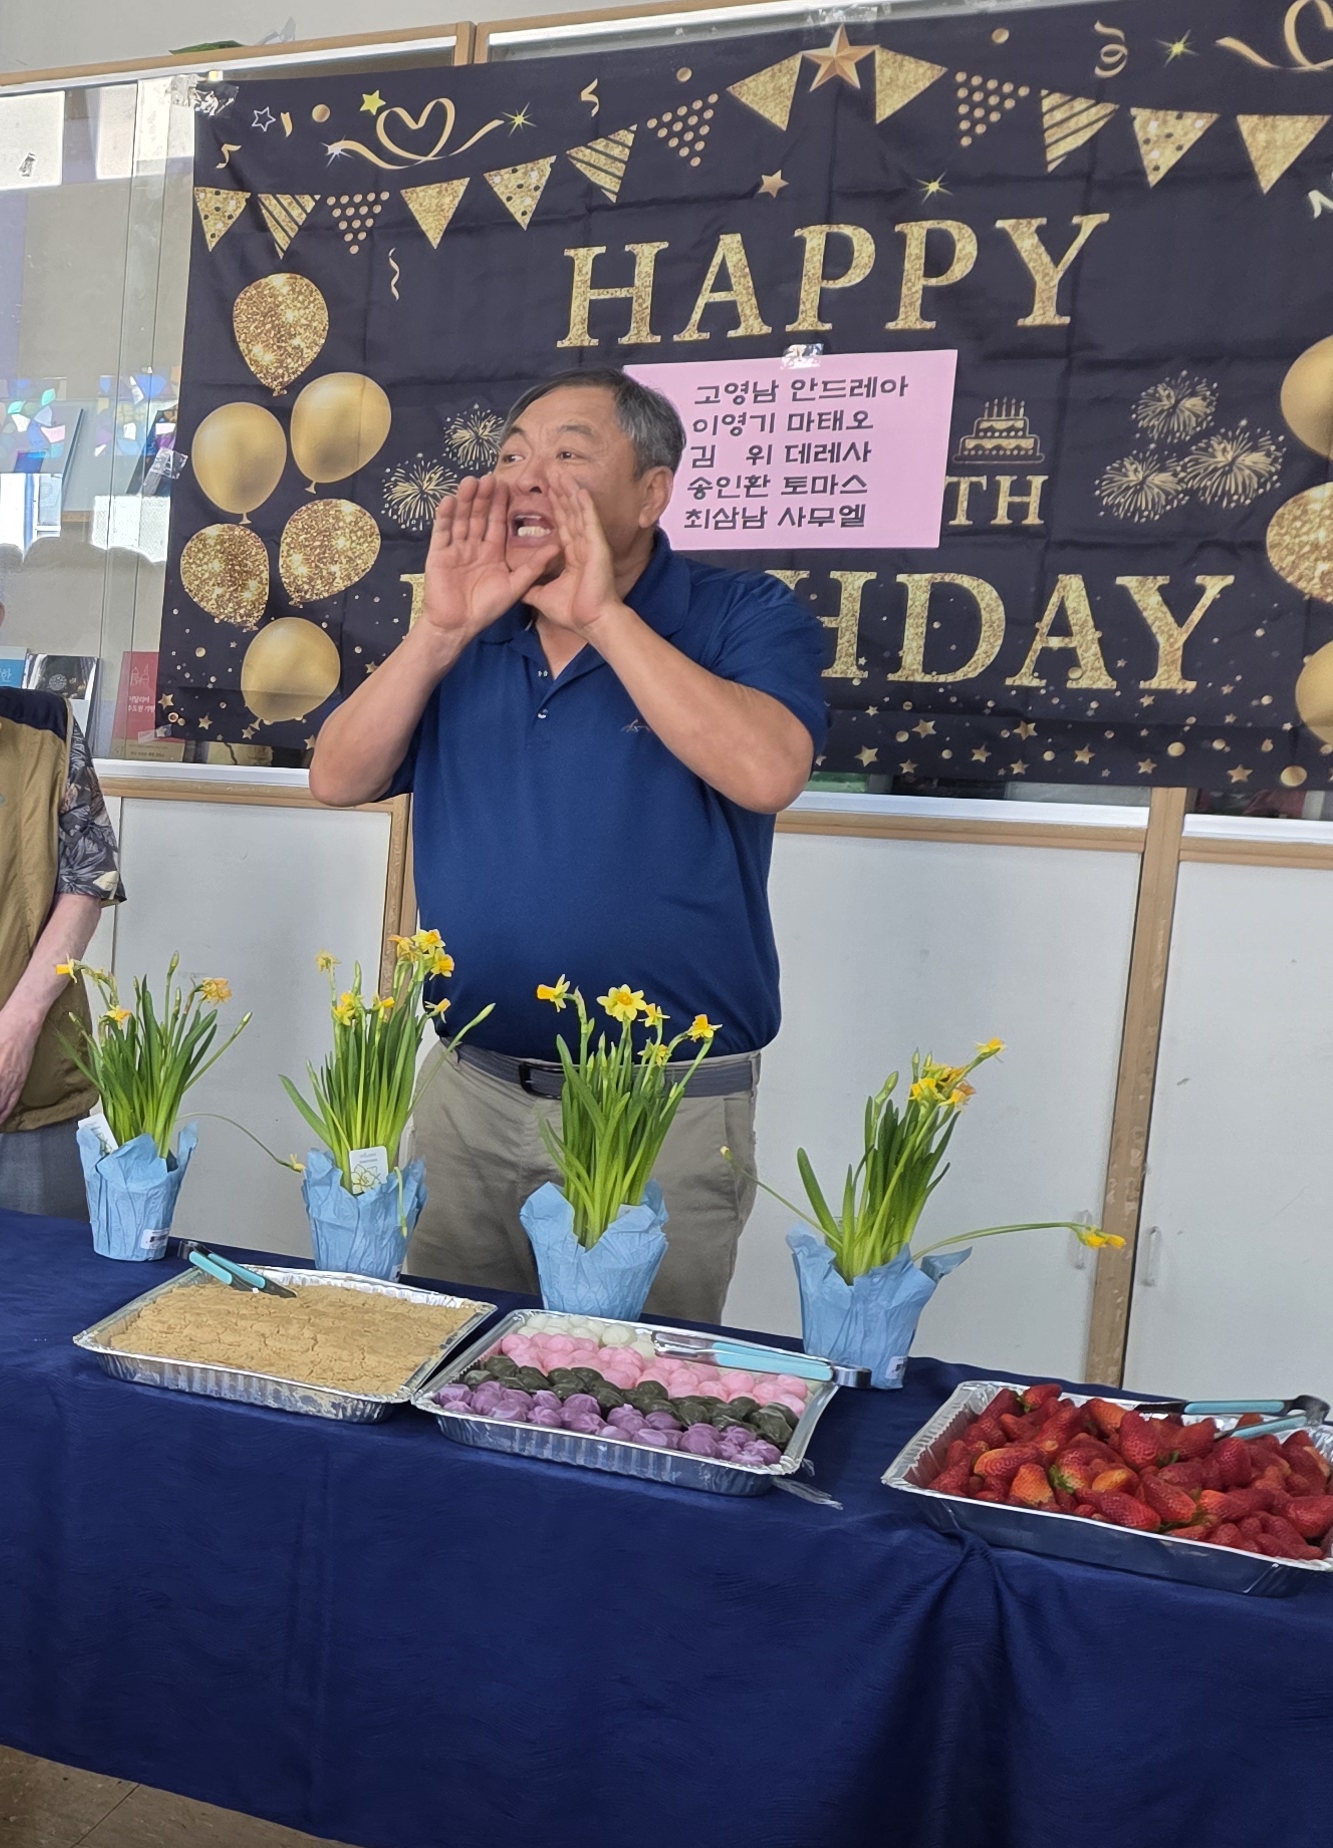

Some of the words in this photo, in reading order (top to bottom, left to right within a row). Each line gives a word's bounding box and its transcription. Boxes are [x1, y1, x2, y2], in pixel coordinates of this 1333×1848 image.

[557, 212, 1111, 348] HAPPY
[694, 380, 779, 405] 고영남
[790, 376, 909, 402] 안드레아
[692, 412, 775, 437] 이영기
[787, 409, 874, 432] 마태오
[690, 444, 715, 469] 김
[745, 443, 772, 466] 위
[784, 440, 872, 465] 데레사
[687, 474, 771, 499] 송인환
[780, 474, 868, 496] 토마스
[683, 506, 768, 531] 최삼남
[777, 503, 867, 528] 사무엘
